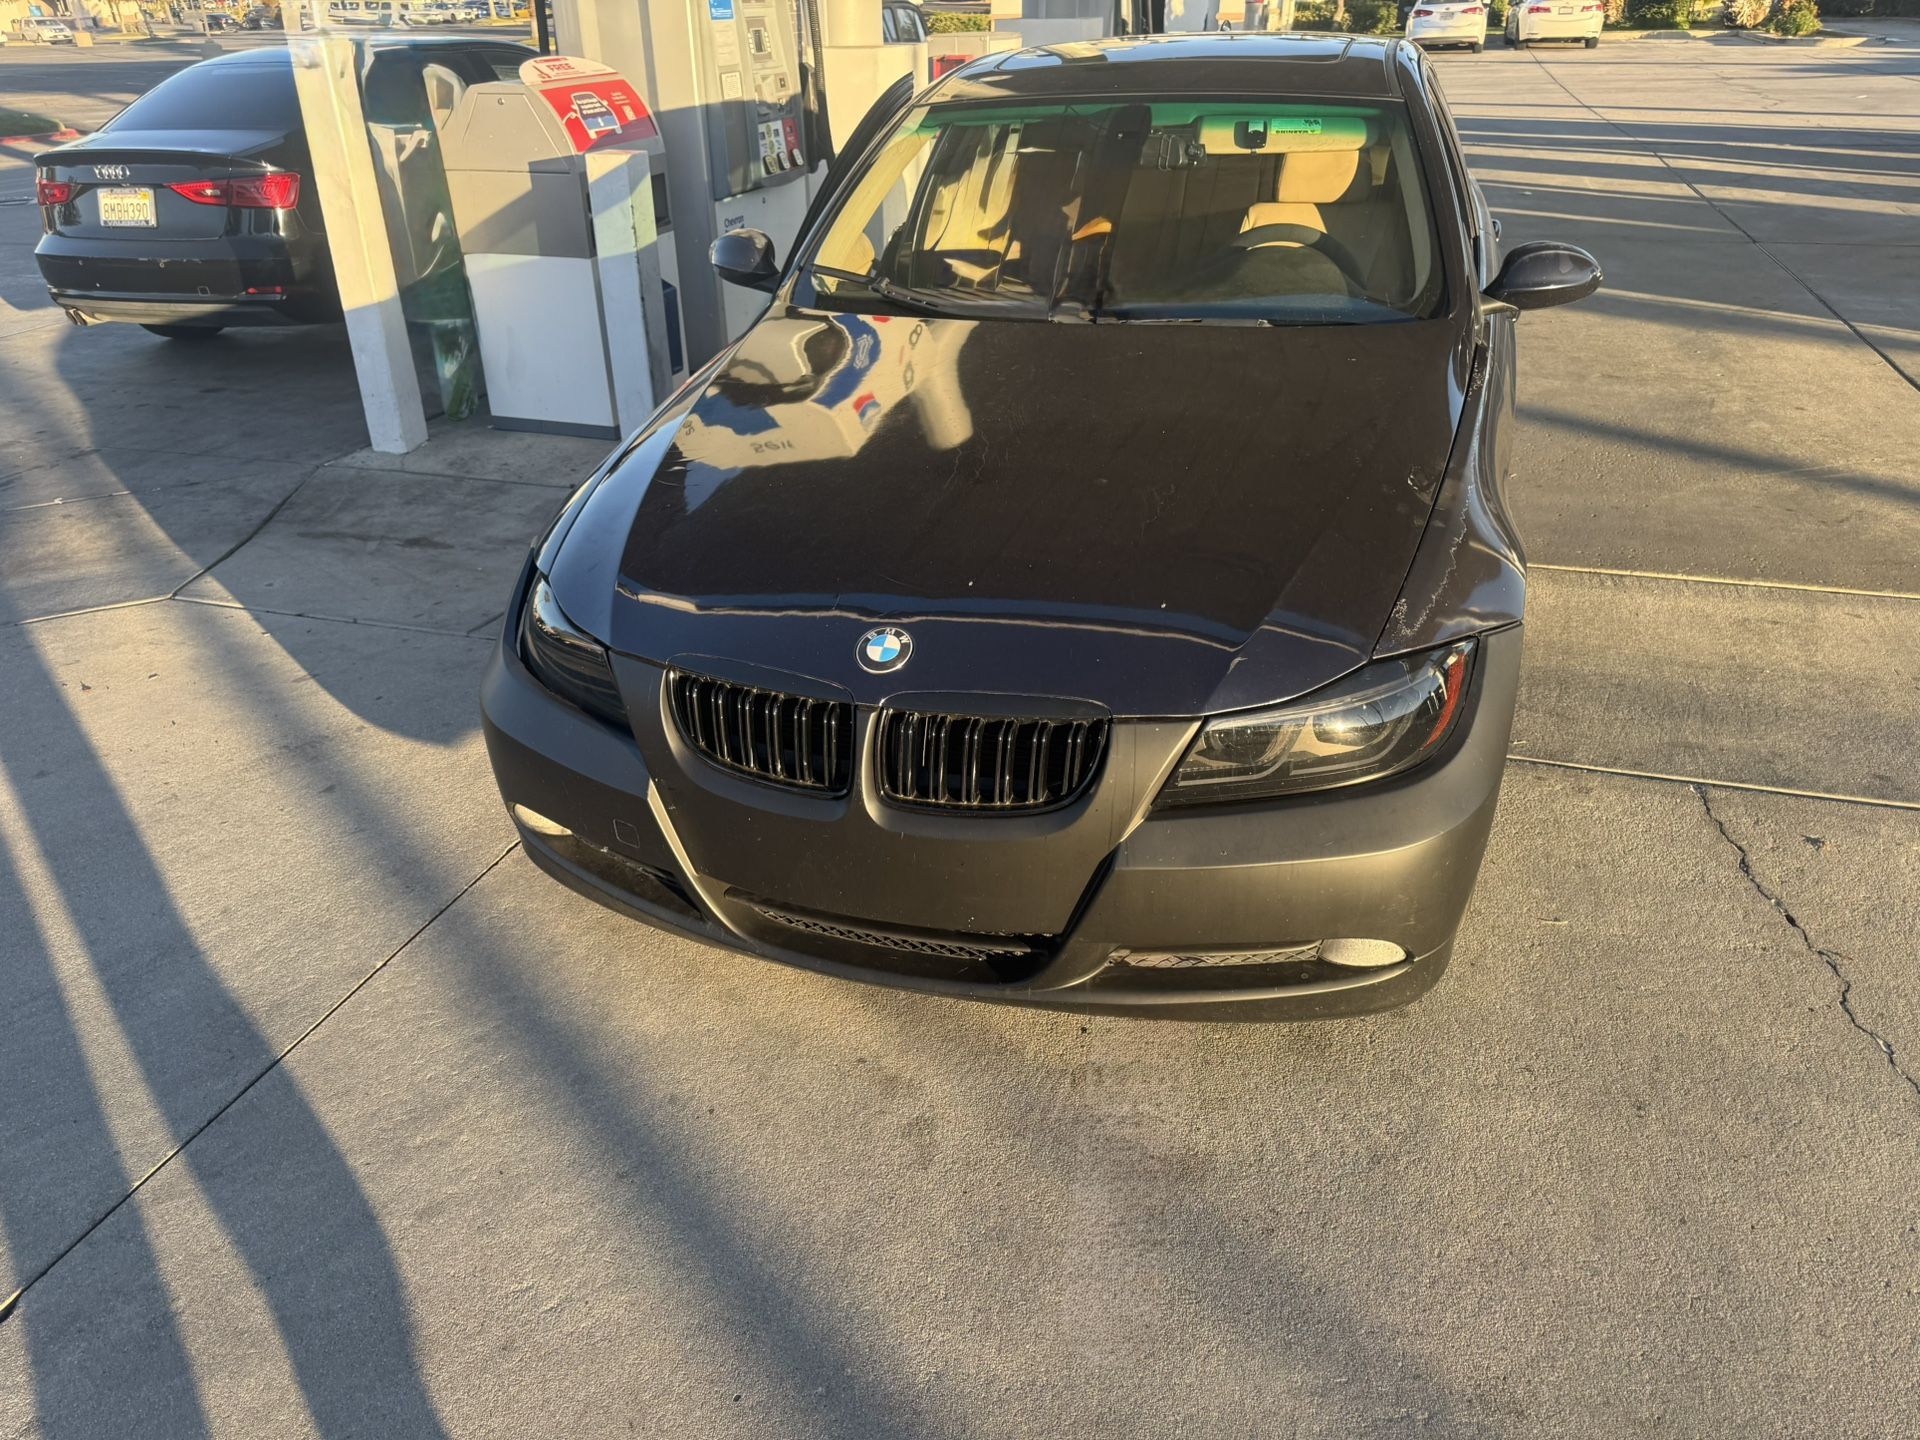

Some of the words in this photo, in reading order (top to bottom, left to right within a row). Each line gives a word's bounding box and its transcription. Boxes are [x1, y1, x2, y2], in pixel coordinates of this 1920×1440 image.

[546, 62, 575, 72] FREE
[103, 202, 149, 219] 8MBH390
[724, 215, 745, 228] Chevron
[867, 627, 910, 644] BMW
